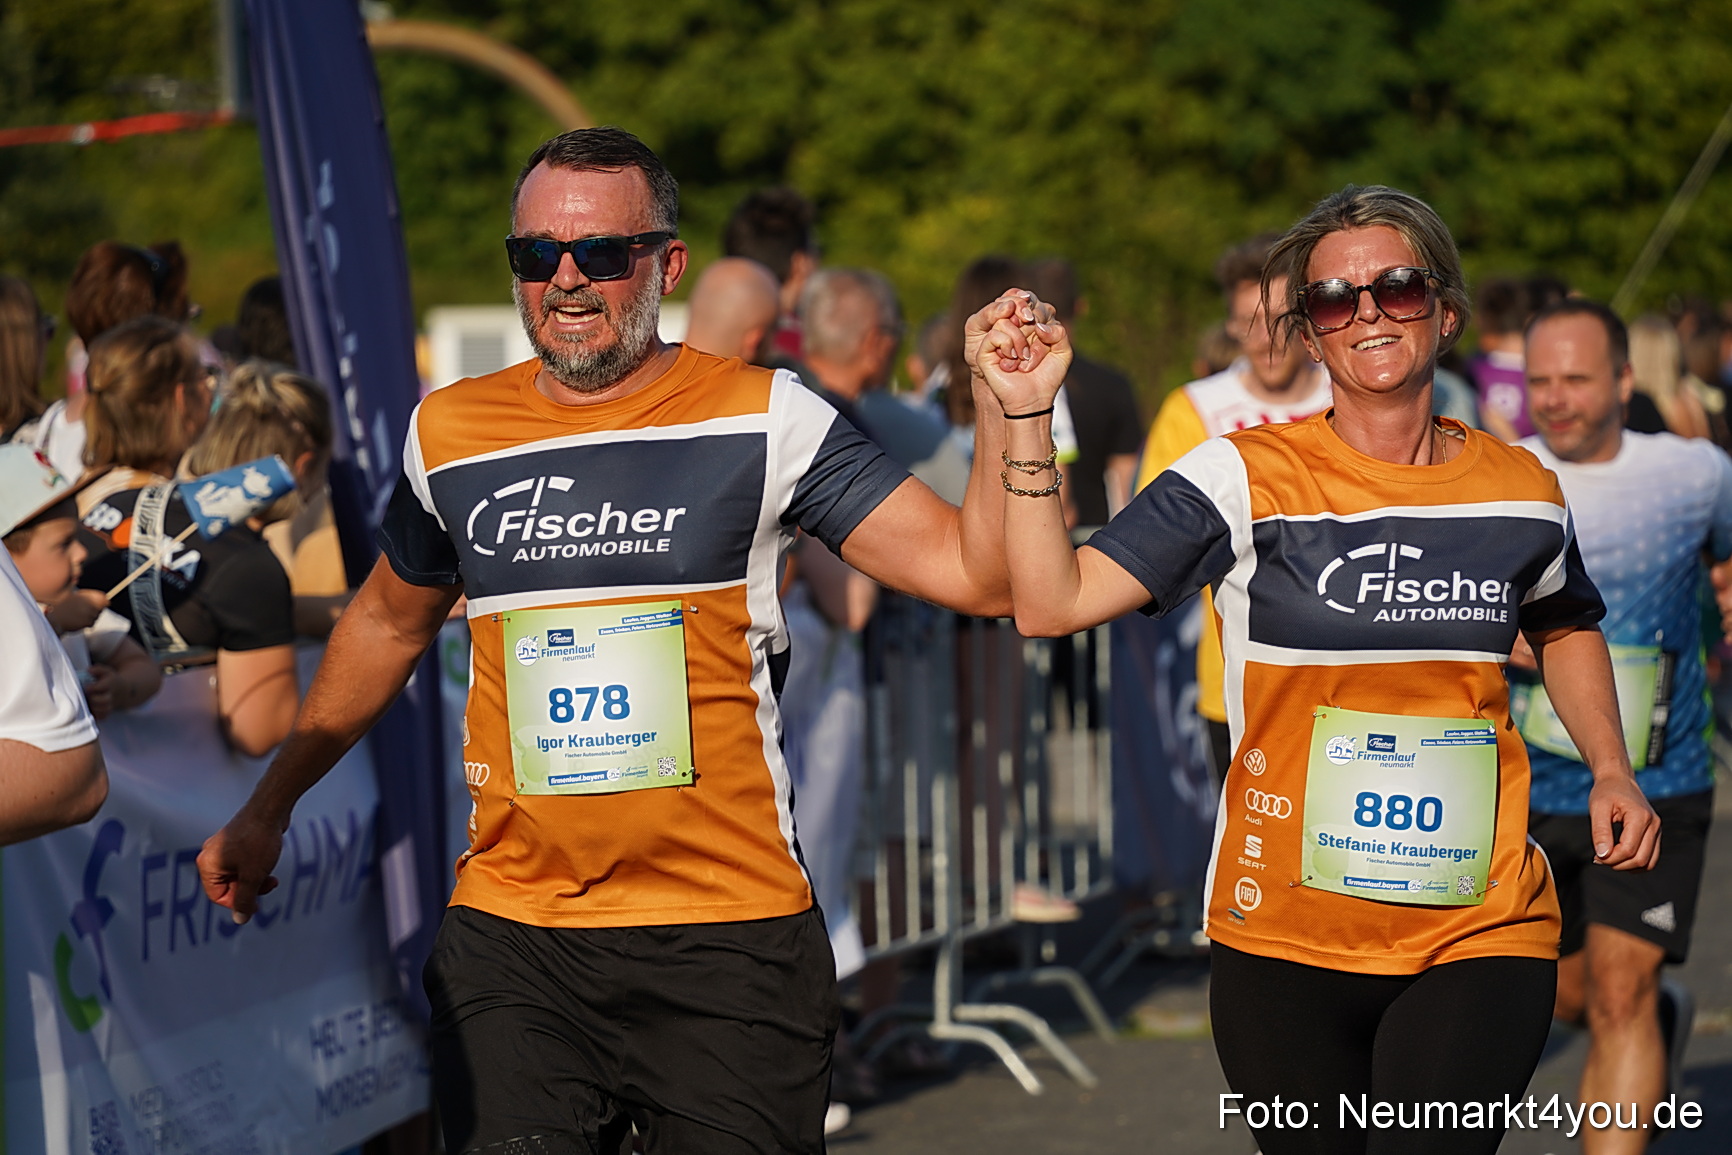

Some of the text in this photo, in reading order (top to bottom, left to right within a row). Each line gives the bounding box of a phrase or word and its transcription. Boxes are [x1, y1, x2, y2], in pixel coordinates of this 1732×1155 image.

[496, 502, 686, 544] Fischer
[512, 538, 671, 563] AUTOMOBILE
[1357, 570, 1512, 604] Fischer
[1373, 607, 1508, 623] AUTOMOBILE
[541, 643, 596, 658] Firmenlauf
[562, 652, 596, 662] neumarkt
[549, 684, 631, 724] 878
[537, 731, 657, 752] Igor Krauberger
[1357, 751, 1417, 762] Firmenlauf
[550, 773, 605, 785] firmenlauf.bayern
[1244, 814, 1263, 826] Audi
[1354, 791, 1443, 833] 880
[1318, 832, 1478, 863] Stefanie Krauberger
[1237, 856, 1267, 871] SEAT
[1366, 857, 1385, 865] Fischer
[1386, 859, 1415, 867] Automobile
[1346, 878, 1405, 890] firmenlauf.bayern
[1240, 885, 1256, 903] FIAT
